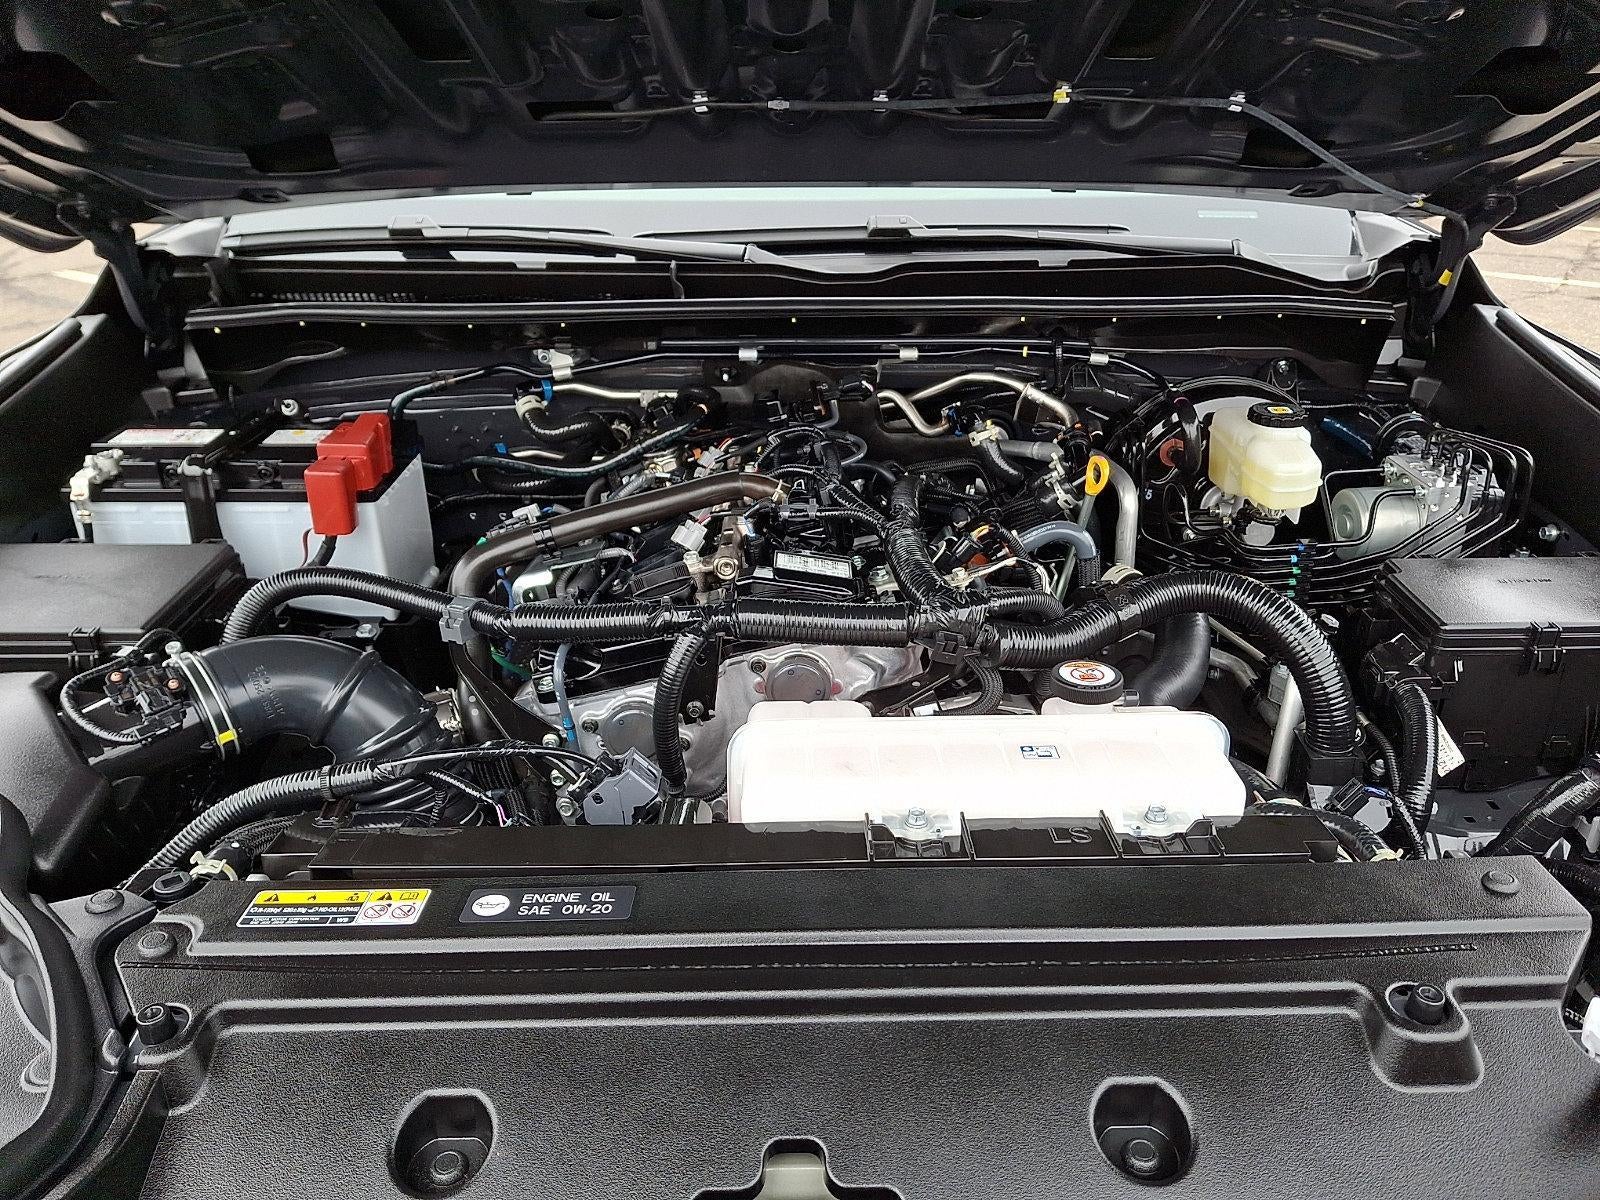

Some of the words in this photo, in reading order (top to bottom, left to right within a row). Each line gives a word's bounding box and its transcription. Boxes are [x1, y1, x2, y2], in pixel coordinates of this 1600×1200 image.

[1048, 827, 1092, 844] LS
[521, 892, 581, 903] ENGINE
[590, 892, 615, 902] OIL
[517, 905, 552, 915] SAE
[561, 904, 613, 914] 0W-20
